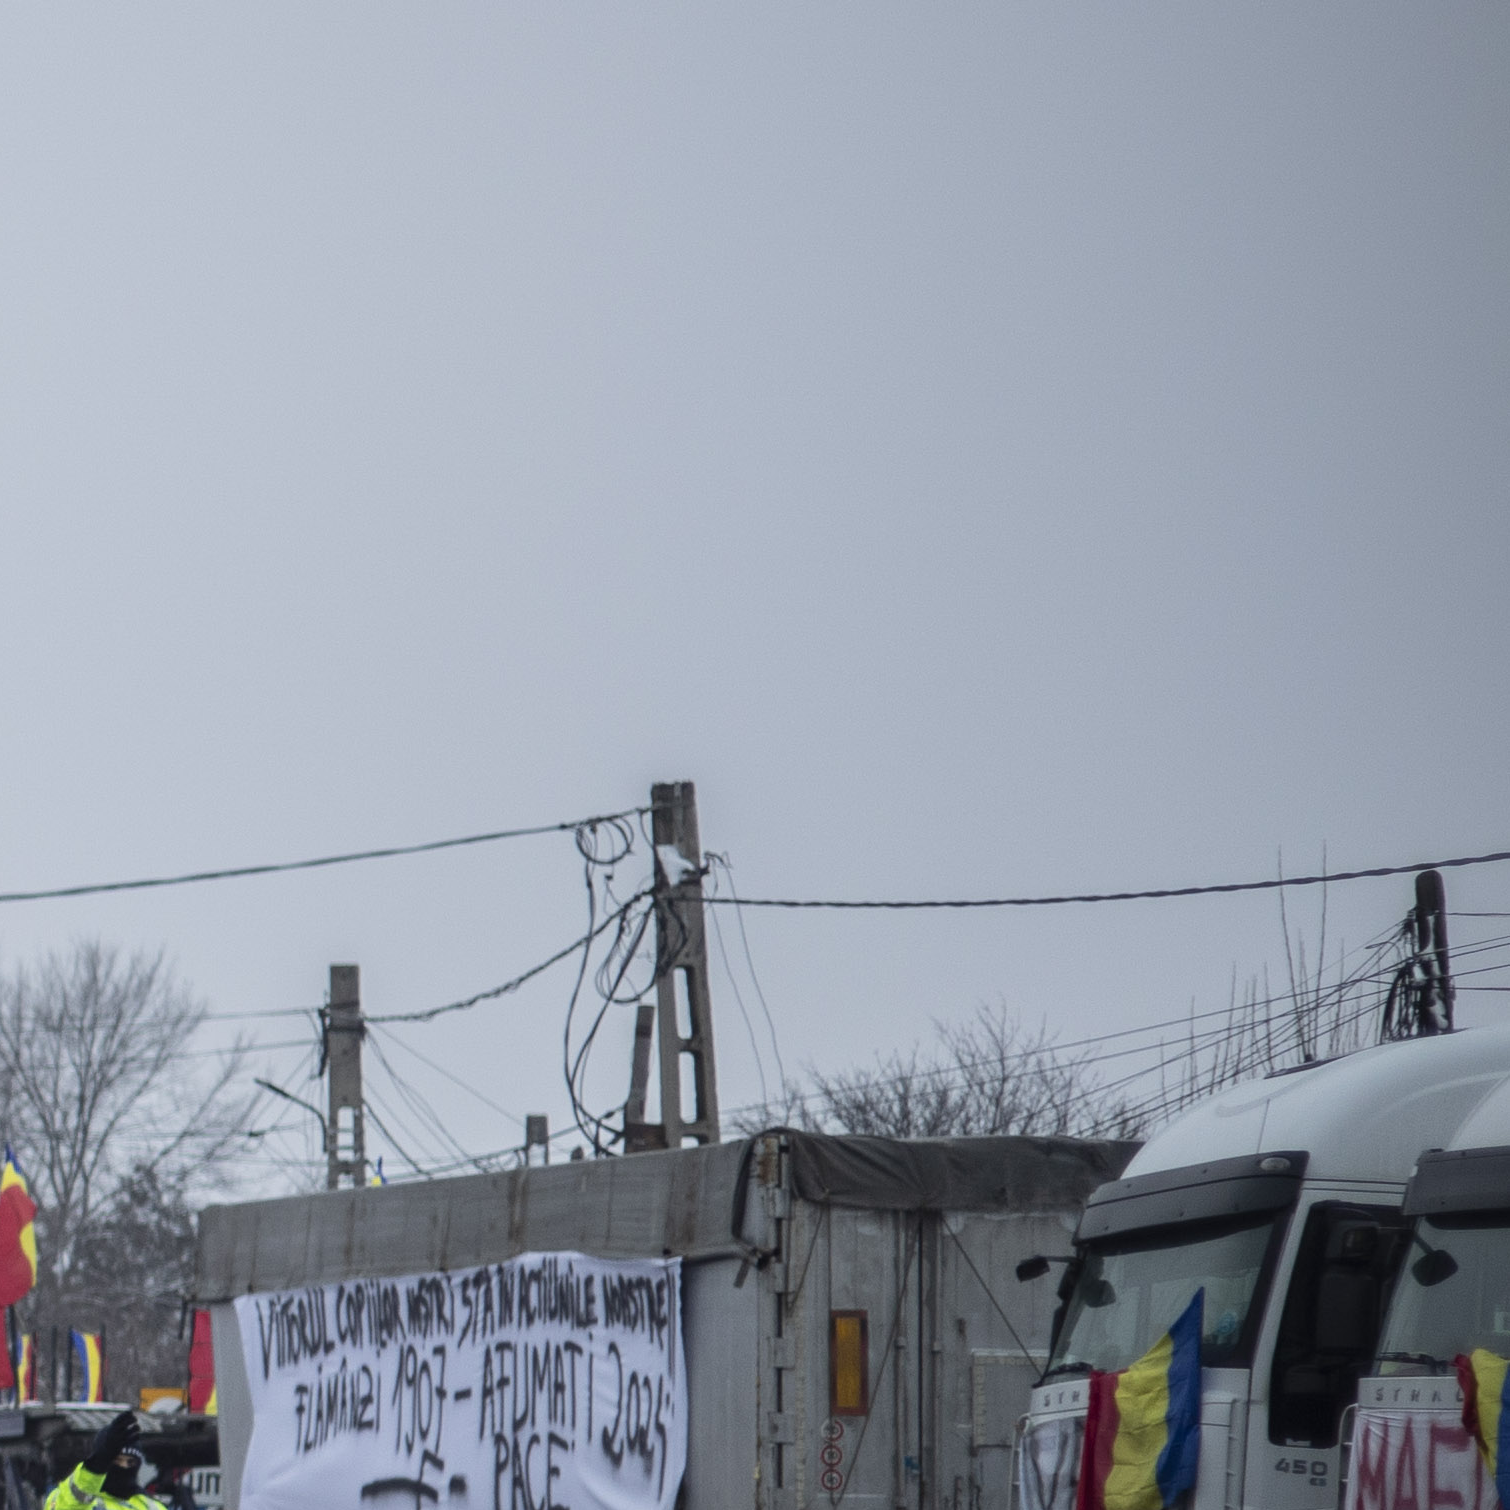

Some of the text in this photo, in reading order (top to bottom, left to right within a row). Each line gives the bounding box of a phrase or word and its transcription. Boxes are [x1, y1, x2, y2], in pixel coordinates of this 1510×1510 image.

[392, 1344, 447, 1458] 1907
[1375, 1386, 1464, 1403] STRAL
[1274, 1458, 1328, 1477] 450
